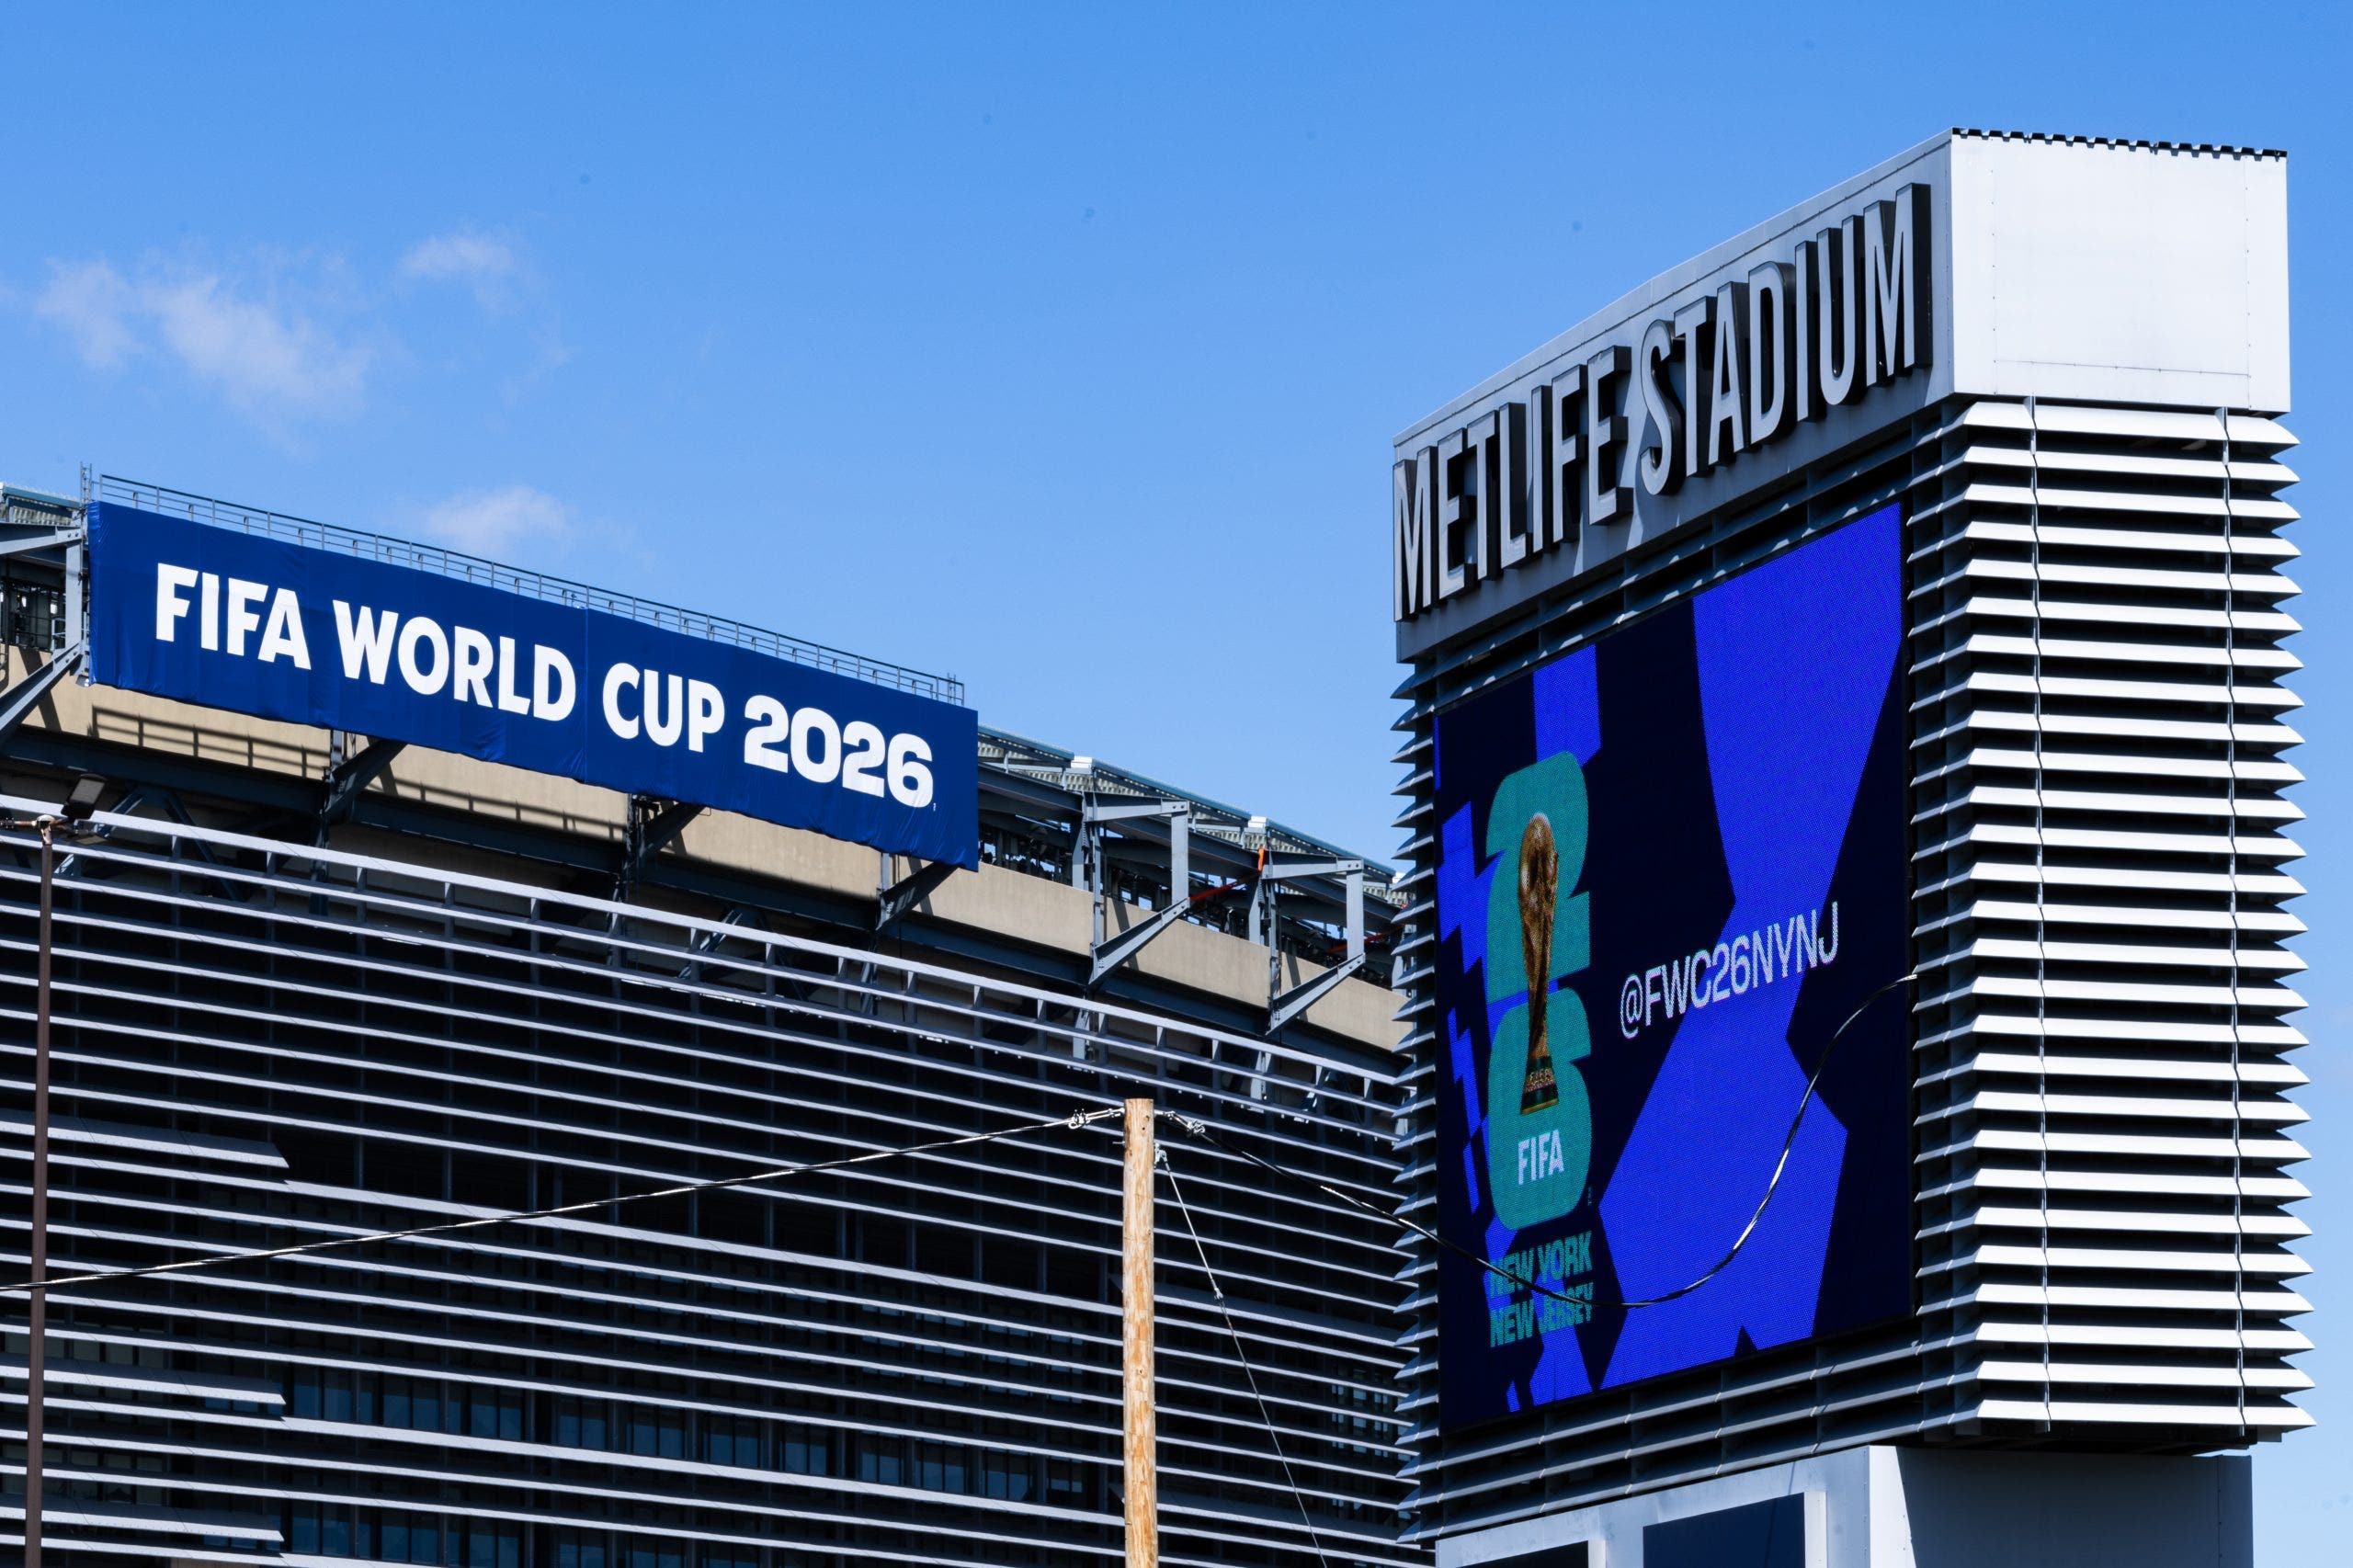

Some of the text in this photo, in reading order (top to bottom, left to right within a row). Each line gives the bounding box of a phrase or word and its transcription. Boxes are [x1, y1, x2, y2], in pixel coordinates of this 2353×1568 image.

[1392, 183, 1931, 622] METLIFE STADIUM
[155, 562, 934, 808] FIFA WORLD CUP 2026
[1620, 901, 1839, 1040] @FWC26NYNJ
[1518, 1130, 1564, 1186] FIFA
[1489, 1231, 1594, 1299] NEW YORK
[1490, 1281, 1595, 1348] NEW JERSEY
